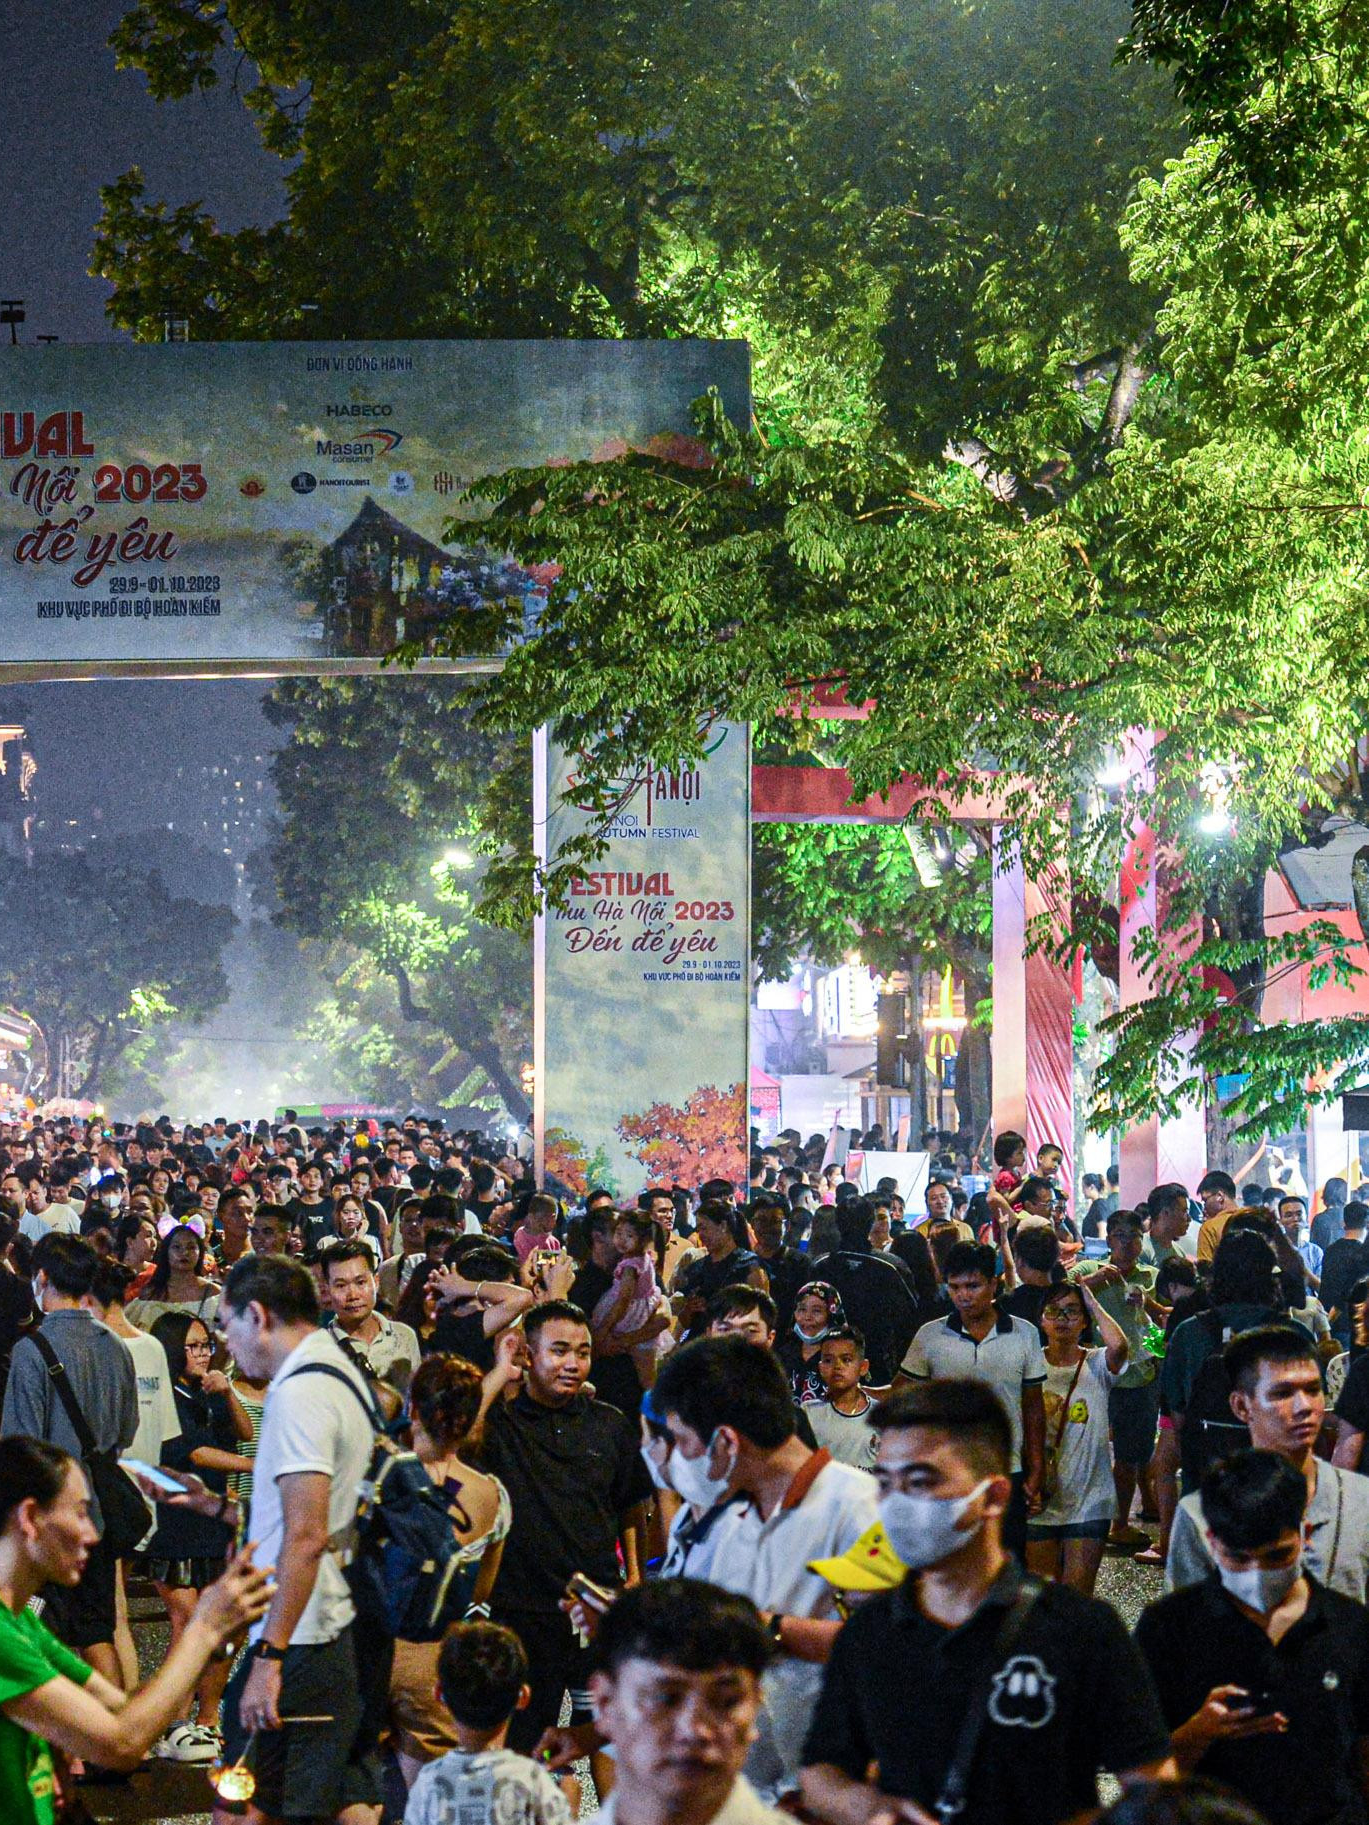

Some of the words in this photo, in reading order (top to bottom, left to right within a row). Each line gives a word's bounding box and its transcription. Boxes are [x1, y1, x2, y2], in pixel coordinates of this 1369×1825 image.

[326, 404, 392, 417] HABECO
[317, 441, 374, 456] Masan
[332, 456, 374, 464] consumer
[11, 463, 81, 516] Nội
[93, 463, 208, 503] 2023
[319, 478, 370, 487] HANOITOURIST
[14, 504, 94, 564] để
[71, 516, 180, 588] yêu
[37, 600, 66, 618] KHU
[92, 595, 118, 618] PHỐ
[134, 598, 151, 619] BỘ
[153, 596, 187, 617] HOÀN
[189, 593, 221, 616] KIẾM
[652, 828, 700, 839] FESTIVAL
[571, 873, 674, 896] ESTIVAL
[593, 899, 624, 922] Hà
[631, 898, 667, 927] Nội
[675, 901, 735, 921] 2023
[565, 924, 623, 953] Đến
[632, 922, 674, 951] để
[662, 929, 718, 965] yêu
[643, 973, 657, 981] KHU
[705, 969, 723, 981] HOÀN
[724, 968, 741, 981] KIẾM
